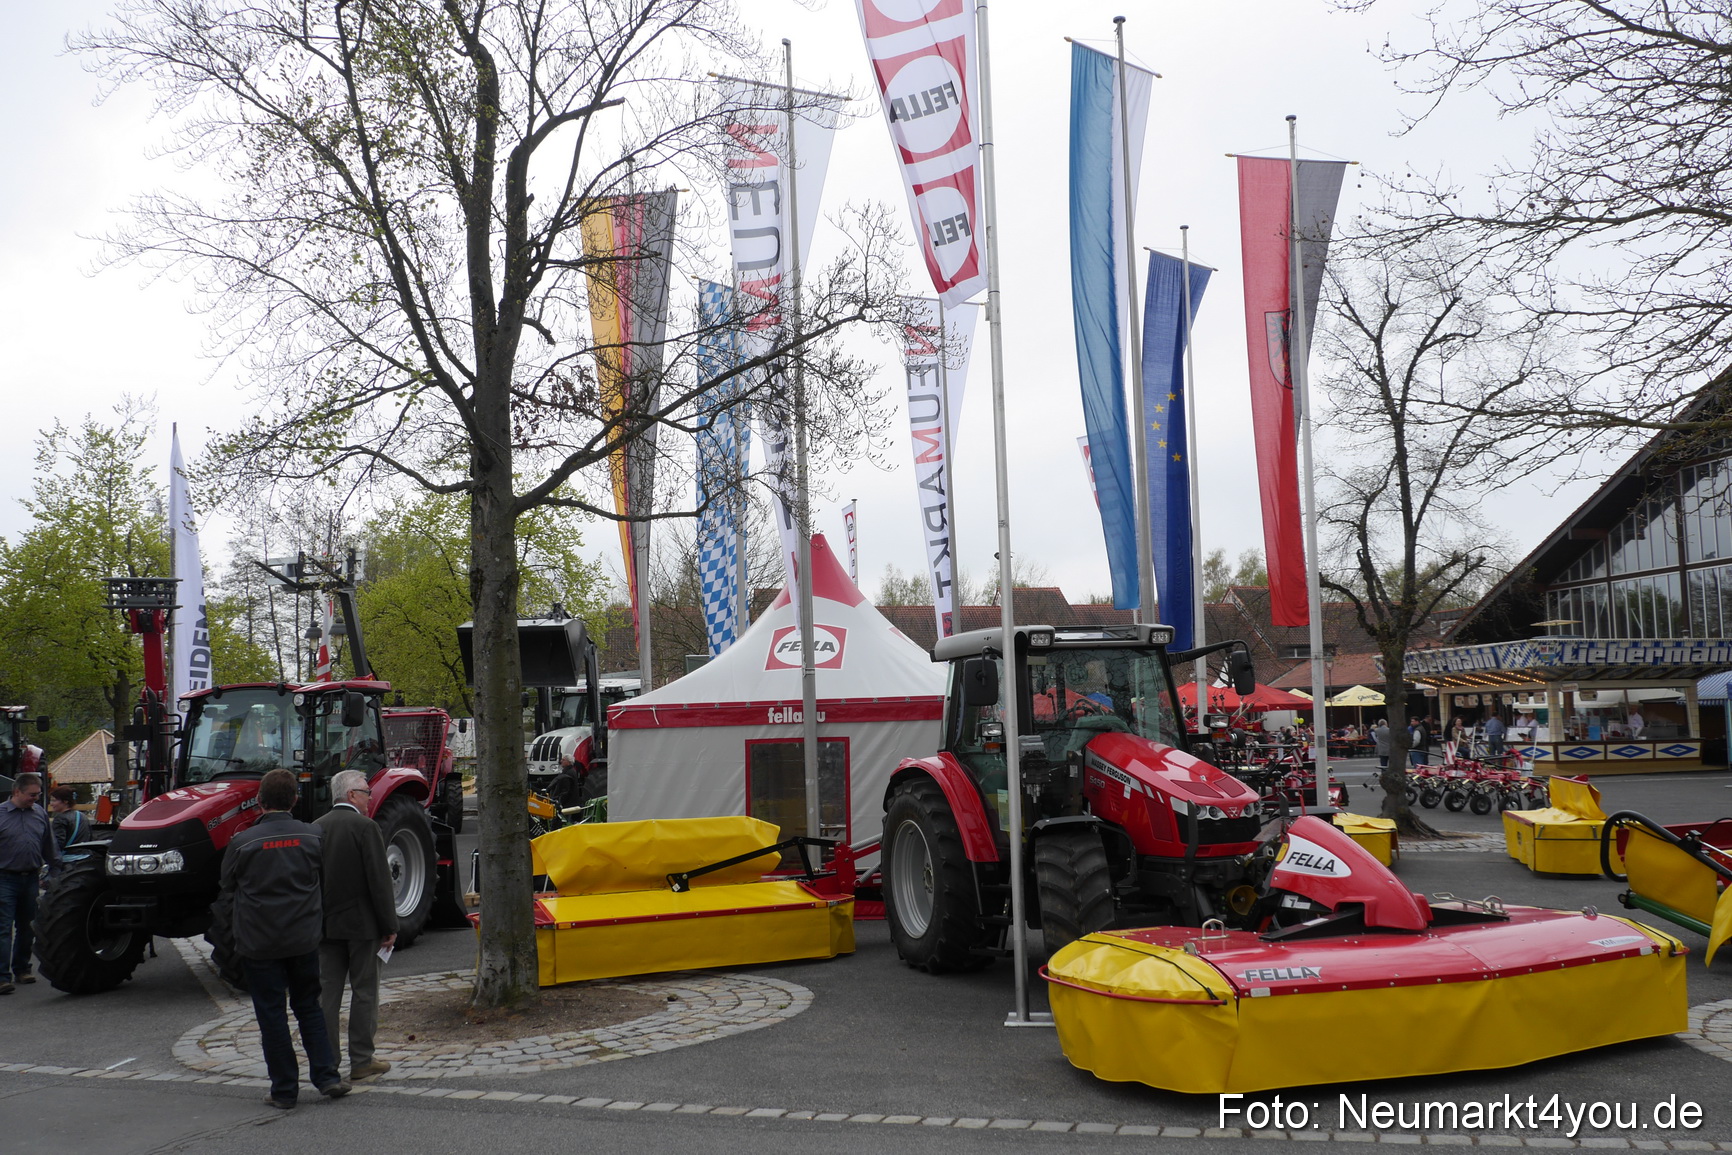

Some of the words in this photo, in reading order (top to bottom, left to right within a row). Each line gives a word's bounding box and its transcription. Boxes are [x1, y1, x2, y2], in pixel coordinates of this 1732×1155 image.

[776, 640, 836, 654] FELA
[1562, 643, 1732, 664] Lieberman
[1402, 652, 1497, 674] iebermann
[767, 706, 826, 724] fella.u
[1106, 766, 1132, 785] FERGUSON
[262, 838, 302, 851] CLAAS
[1286, 851, 1336, 873] FELLA
[1244, 965, 1321, 983] FELLA
